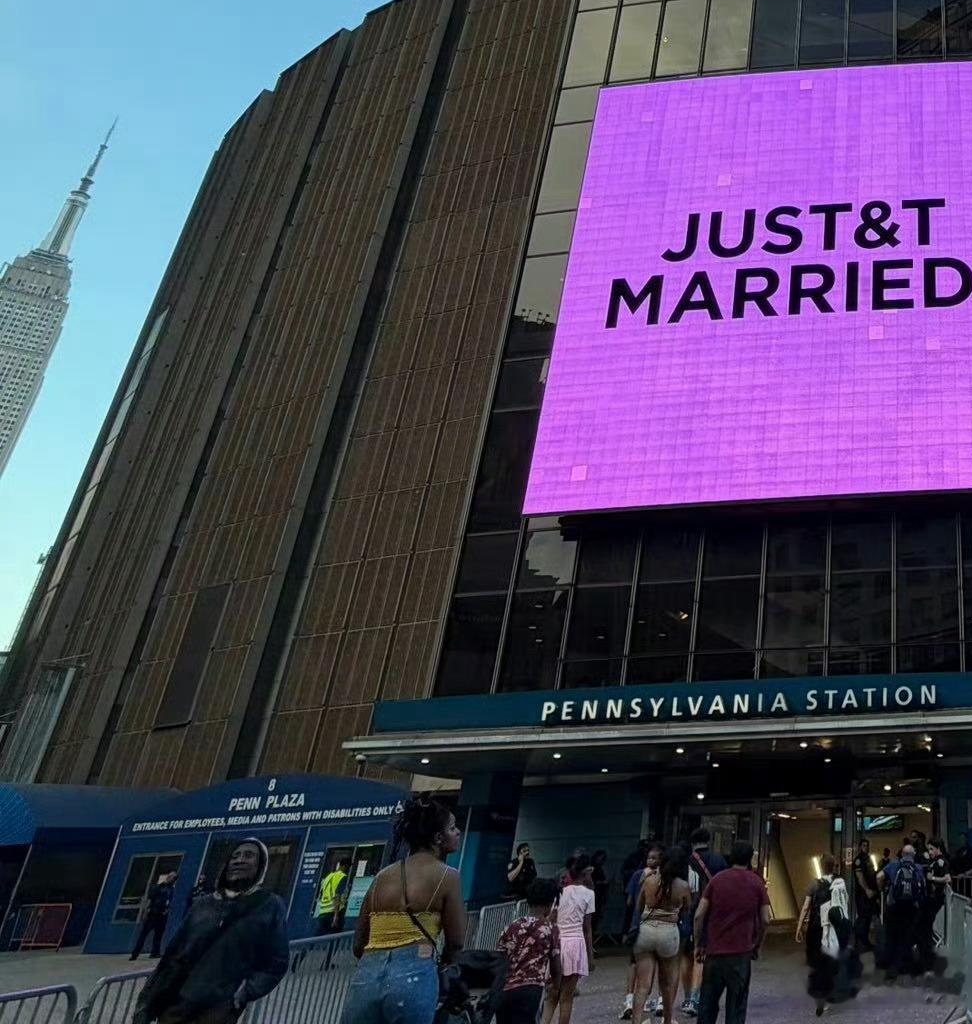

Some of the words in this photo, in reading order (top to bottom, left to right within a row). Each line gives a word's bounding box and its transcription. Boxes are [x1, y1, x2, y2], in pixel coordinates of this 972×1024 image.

[661, 197, 946, 263] JUST&T
[541, 691, 788, 722] PENNSYLVANIA
[805, 684, 938, 711] STATION
[267, 778, 277, 792] 8
[228, 796, 260, 812] PENN
[265, 793, 305, 810] PLAZA
[132, 820, 168, 832] ENTRANCE
[169, 819, 184, 829] FOR
[184, 817, 227, 829] EMPLOYEES,
[228, 815, 251, 826] MEDIA
[251, 814, 267, 824] AND
[268, 812, 301, 823] PATRONS
[302, 810, 323, 821] WITH
[322, 807, 372, 819] DISABILITIES
[373, 805, 394, 816] ONLY
